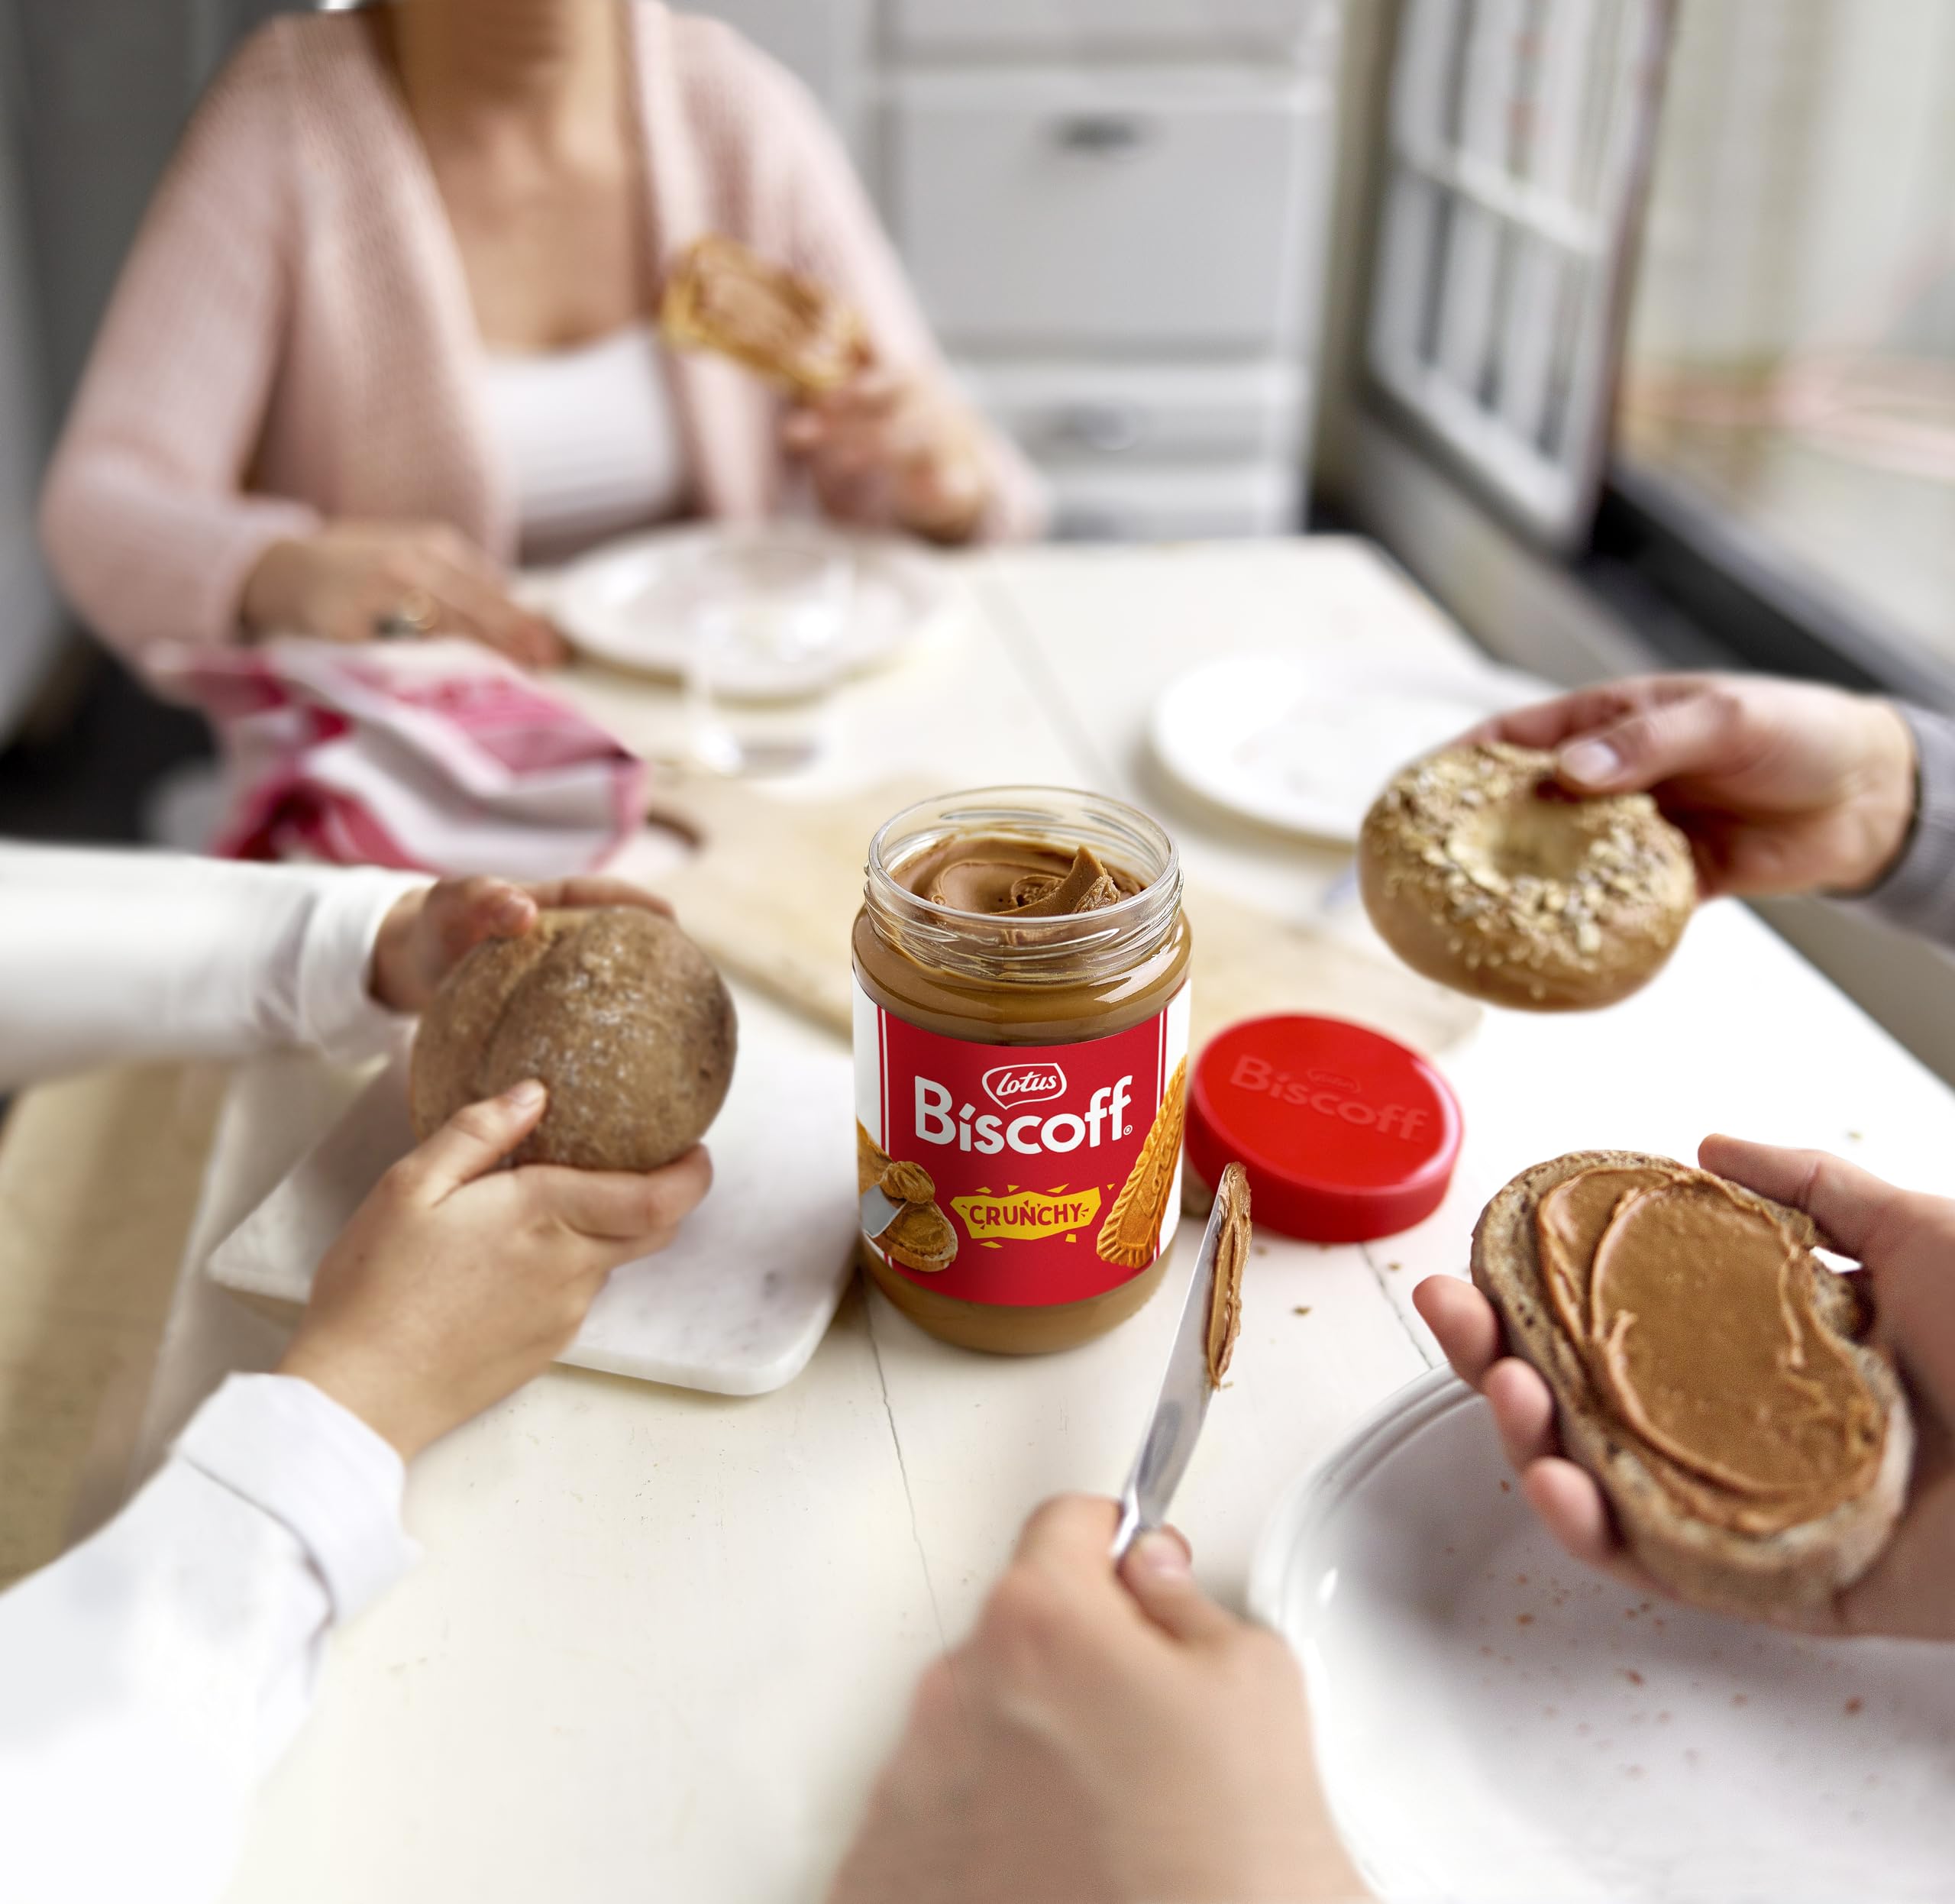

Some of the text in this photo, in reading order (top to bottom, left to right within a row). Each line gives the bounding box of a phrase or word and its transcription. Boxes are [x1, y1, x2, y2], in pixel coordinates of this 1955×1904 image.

[996, 1072, 1057, 1097] Lotus
[1230, 1055, 1429, 1139] Biscoff
[969, 1201, 1083, 1227] CRUNCHY
